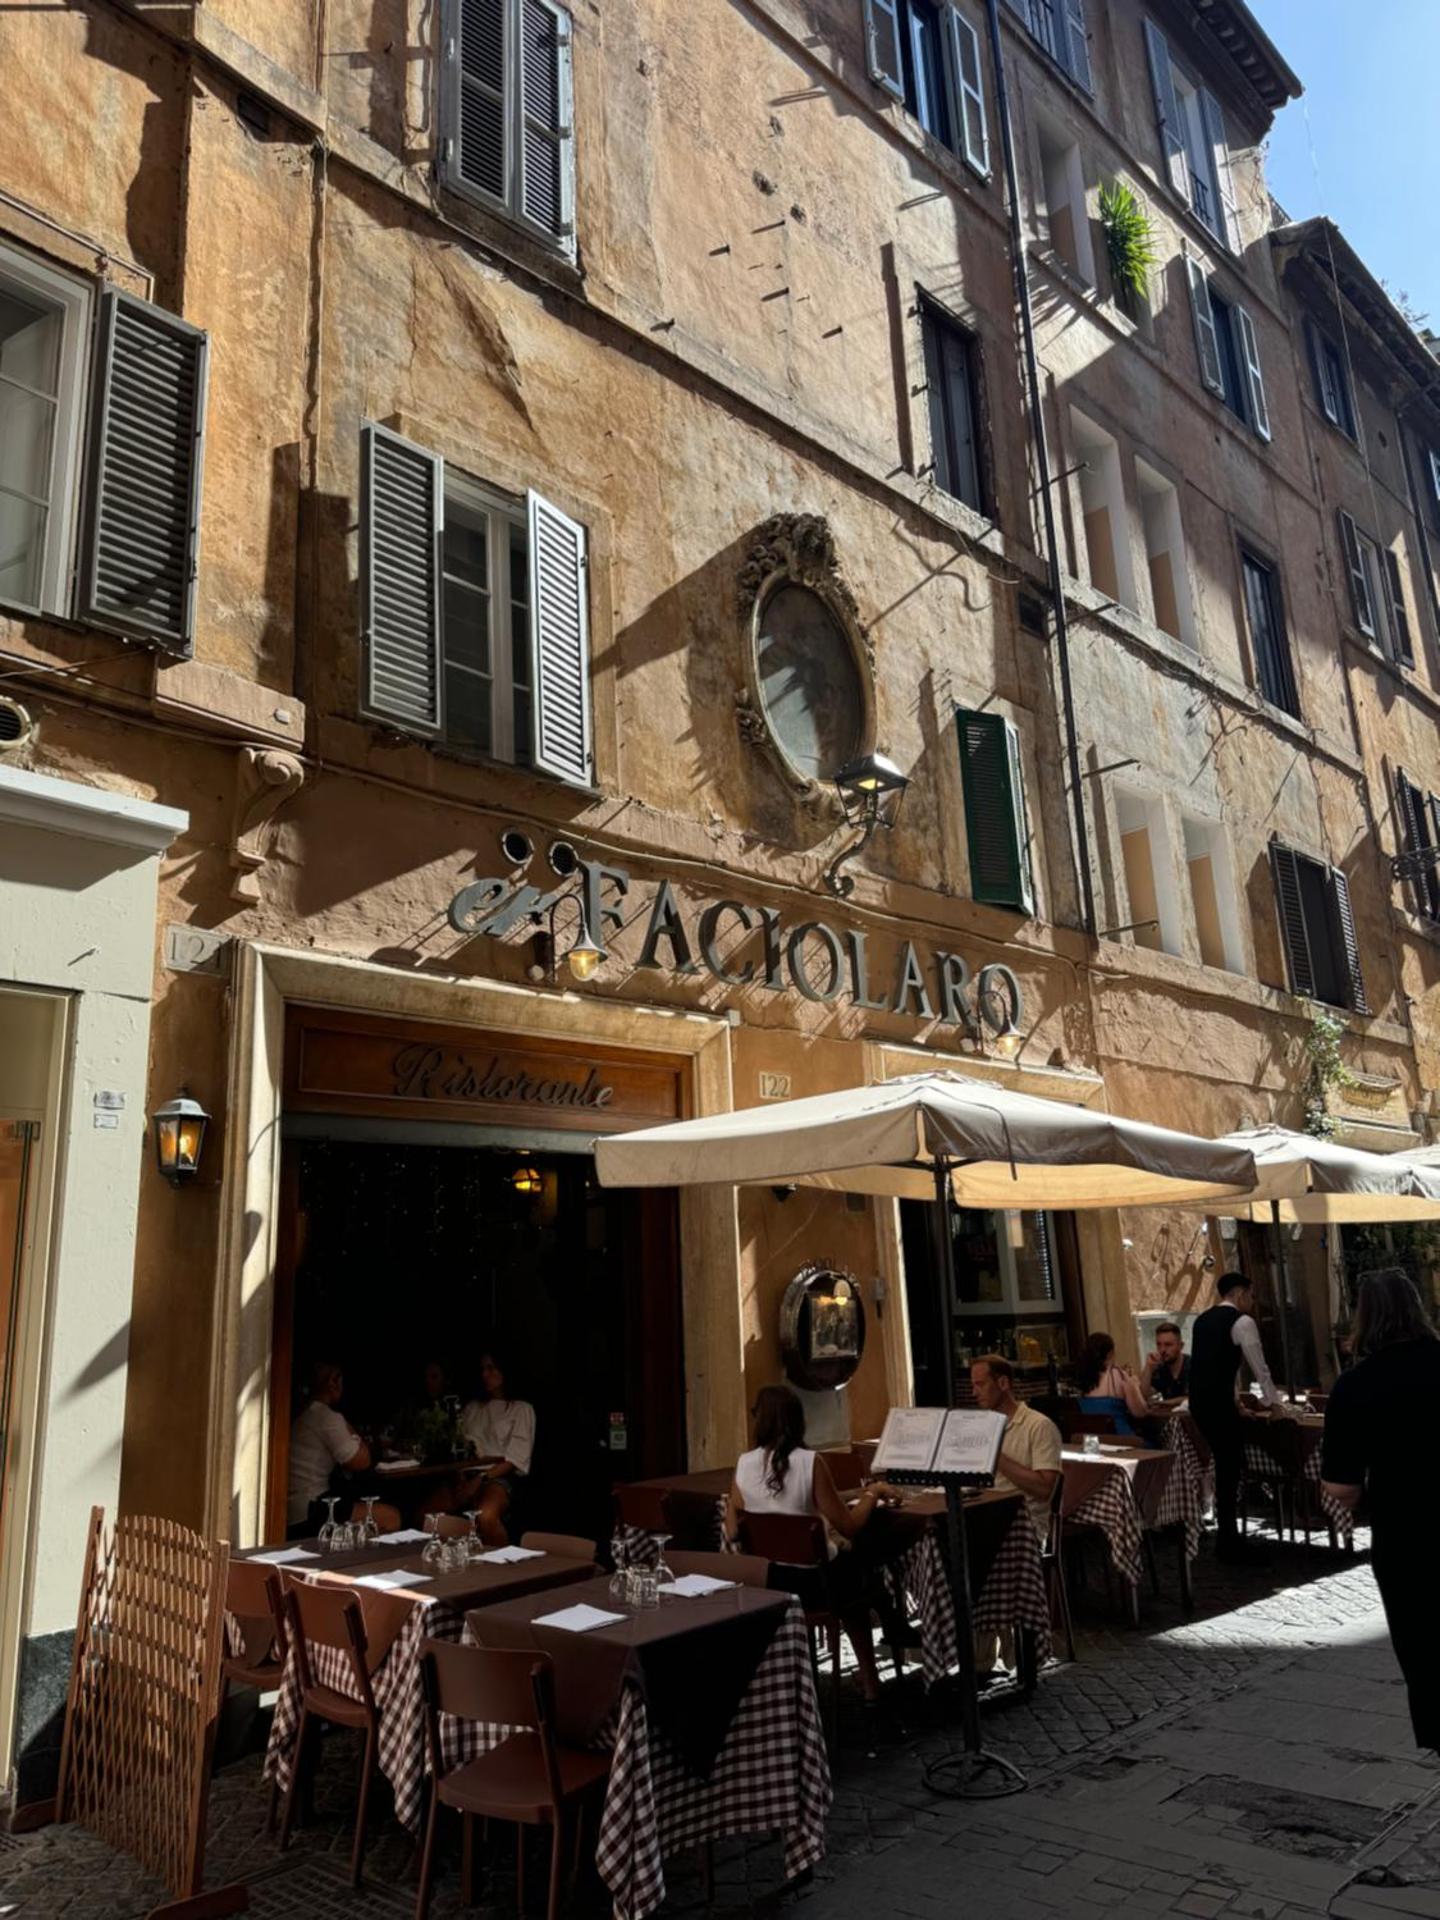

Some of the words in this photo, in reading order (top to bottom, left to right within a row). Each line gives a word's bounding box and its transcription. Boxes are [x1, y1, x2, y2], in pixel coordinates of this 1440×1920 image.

[578, 858, 1025, 1034] FACIOLARO
[392, 1042, 614, 1109] Ristorante
[761, 1074, 789, 1097] 122
